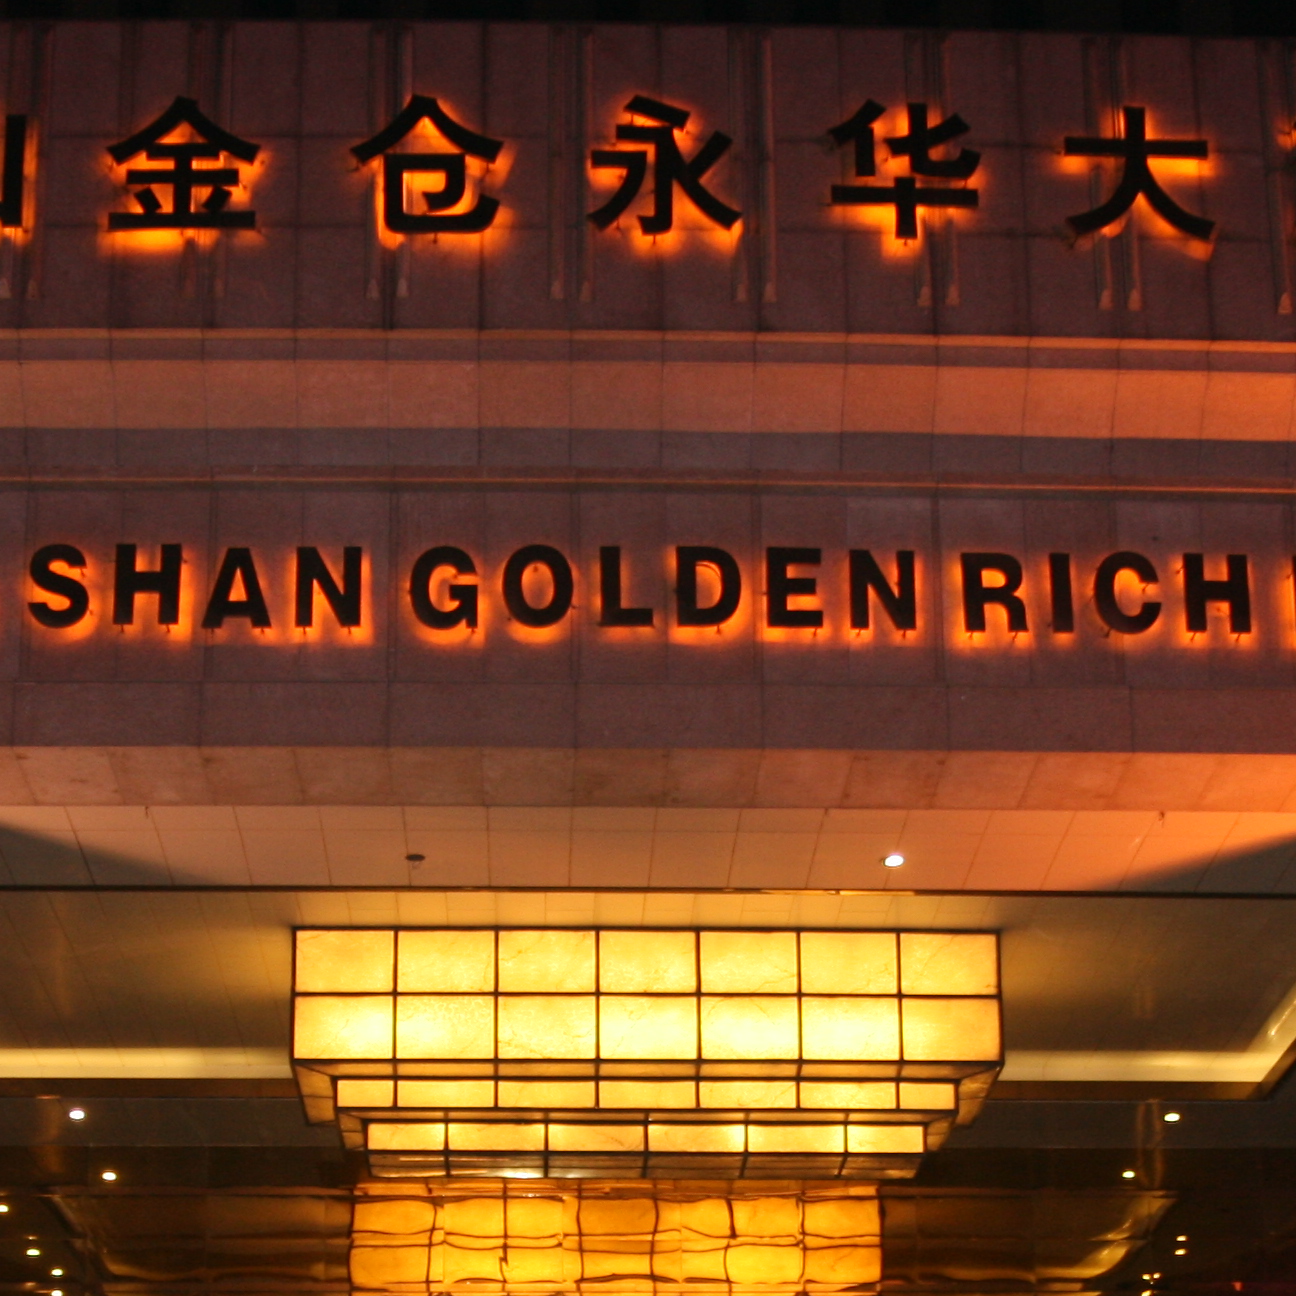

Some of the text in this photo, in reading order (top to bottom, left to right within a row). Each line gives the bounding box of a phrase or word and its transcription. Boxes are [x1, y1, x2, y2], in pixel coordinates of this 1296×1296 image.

[27, 542, 364, 631] SHAN
[408, 544, 917, 633] GOLDEN
[959, 550, 1252, 636] RICH
